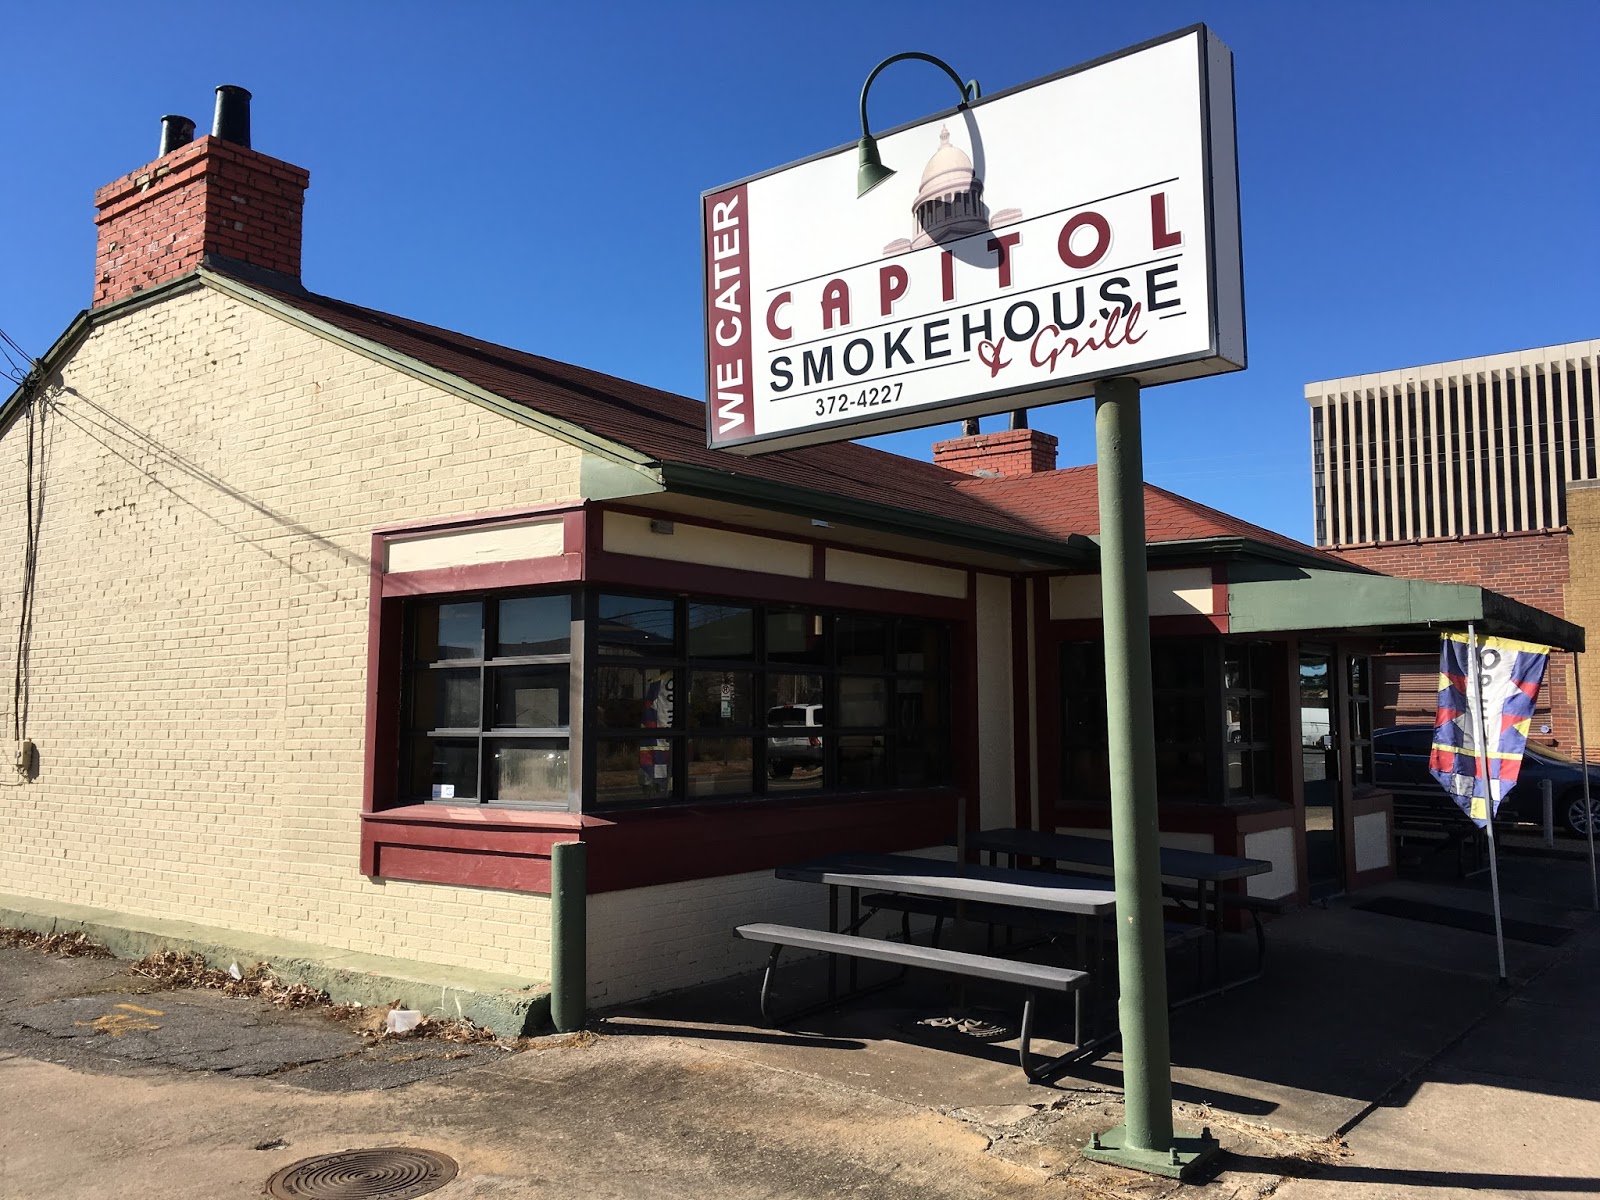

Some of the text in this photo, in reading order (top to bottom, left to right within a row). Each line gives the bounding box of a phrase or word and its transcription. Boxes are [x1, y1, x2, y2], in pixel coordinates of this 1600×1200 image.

[712, 195, 745, 434] WE CATER
[766, 192, 1183, 341] CAPITOL
[769, 264, 1182, 393] SMOKEHOUSE
[814, 382, 904, 417] 372-4227
[976, 301, 1149, 378] & Grill
